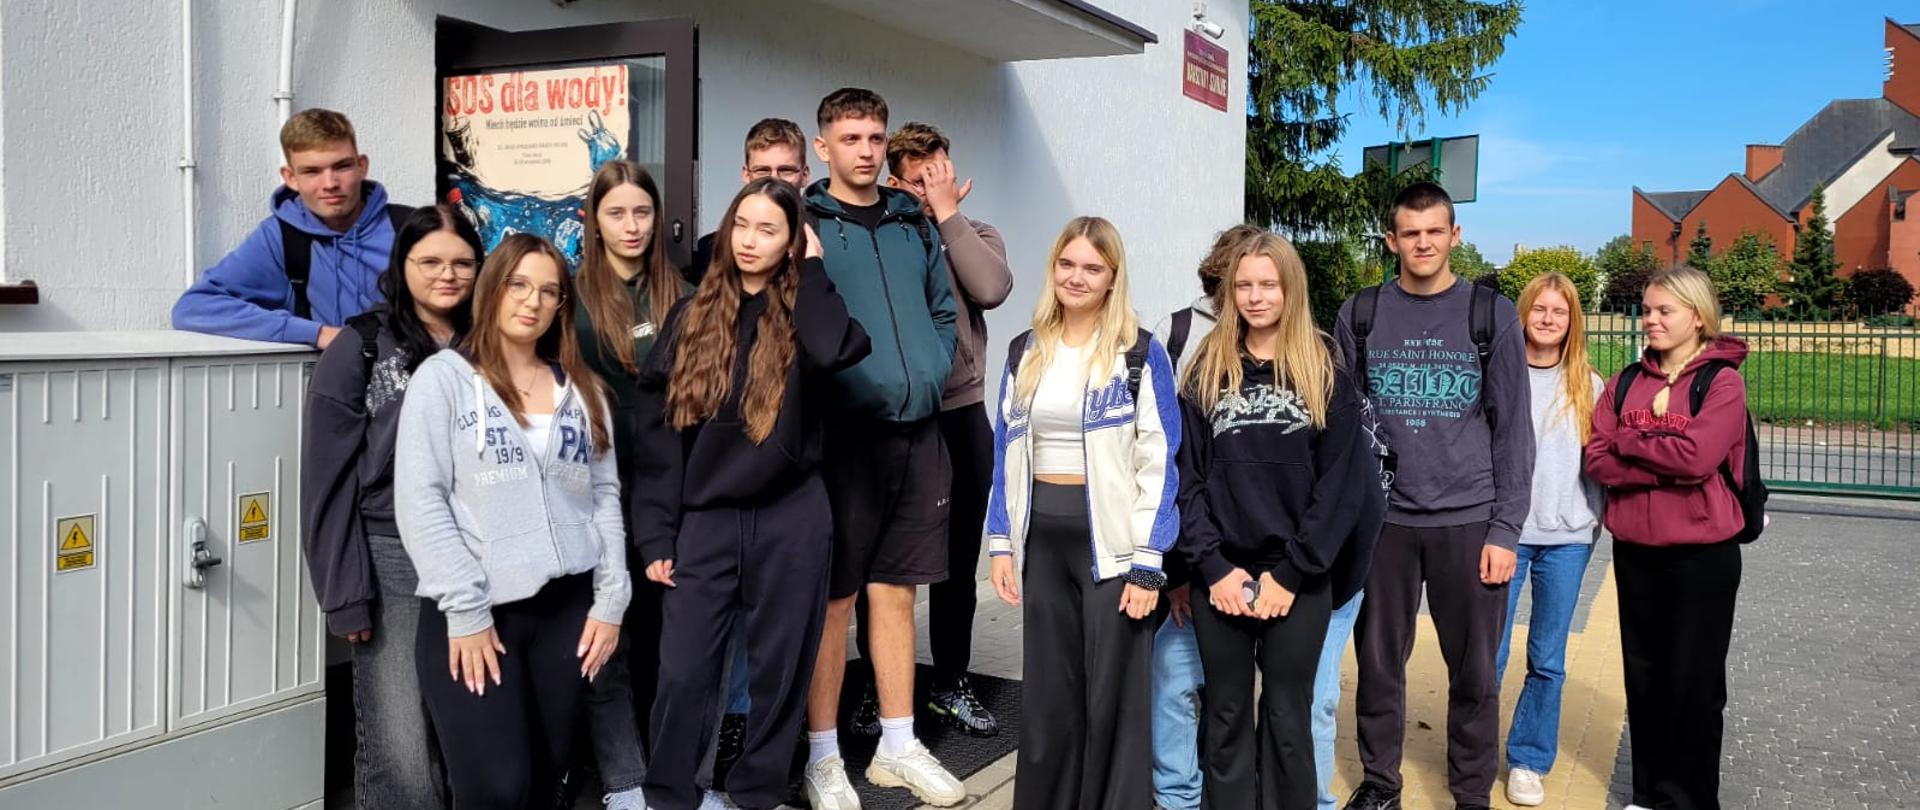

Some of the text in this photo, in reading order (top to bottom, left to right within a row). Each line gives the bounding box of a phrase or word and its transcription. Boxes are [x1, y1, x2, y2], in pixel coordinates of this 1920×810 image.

[446, 64, 627, 116] SOS dla wody!
[550, 116, 558, 127] od
[1368, 350, 1389, 359] RUE
[1392, 350, 1425, 360] SAINT
[1367, 366, 1480, 404] SAINT
[1390, 398, 1471, 410] PARIS/FRANC
